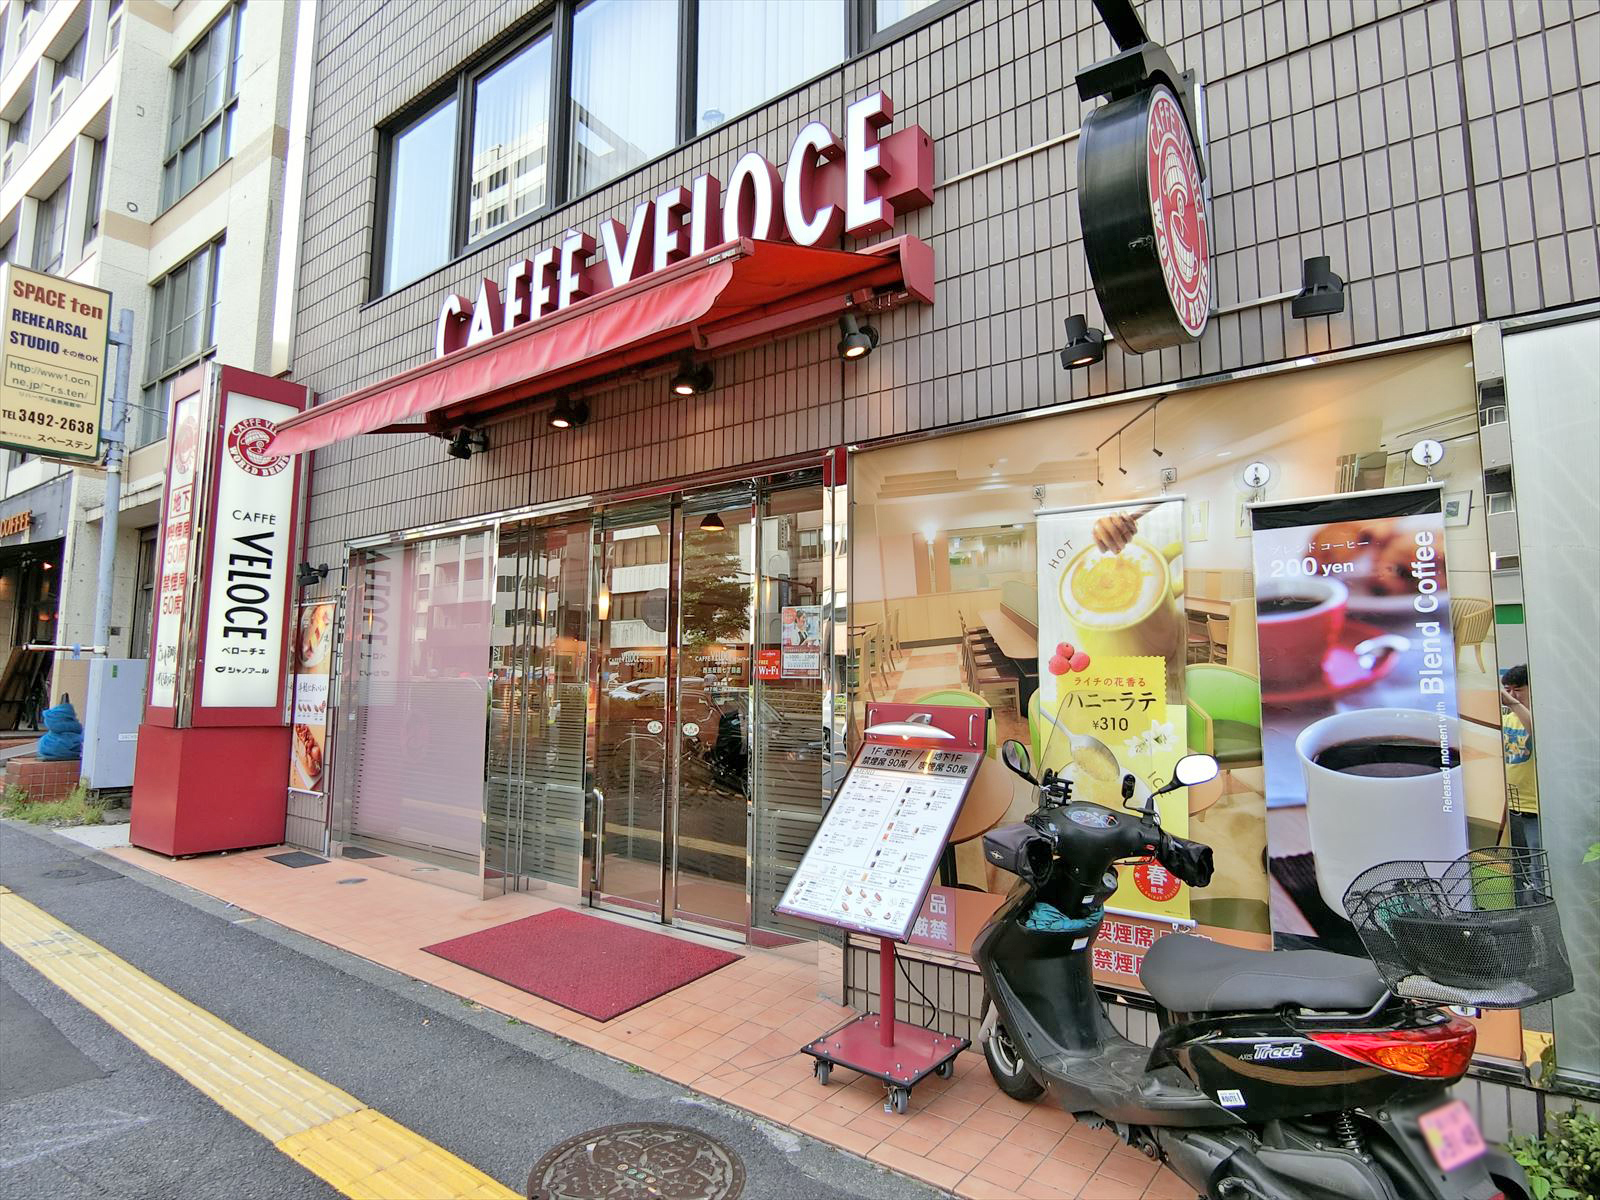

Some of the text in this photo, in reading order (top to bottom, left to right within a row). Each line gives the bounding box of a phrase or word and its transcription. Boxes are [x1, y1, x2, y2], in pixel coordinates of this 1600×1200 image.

[600, 90, 888, 284] VELOCE
[1153, 197, 1209, 327] WORLD BEANS
[13, 279, 103, 320] SPACE ten
[12, 308, 88, 340] REHEARSAL
[10, 330, 60, 354] STUDIO
[2, 409, 17, 420] TEL
[19, 409, 94, 435] 3492-2638
[229, 445, 258, 475] WORLD
[1048, 539, 1074, 570] HOT
[1270, 557, 1355, 578] 200 yen
[223, 531, 275, 640] VELOCE
[1411, 531, 1445, 696] Blend Coffee
[758, 665, 779, 675] Wi-Fi
[1074, 677, 1147, 688] ライチの花香る
[1067, 691, 1156, 712] ハニーラテ
[1092, 717, 1129, 732] ¥310
[945, 764, 968, 774] 50席
[1436, 701, 1453, 813] Released moment with
[1147, 864, 1168, 887] 春
[930, 893, 947, 915] 品
[1238, 1043, 1303, 1061] AXIS Treet
